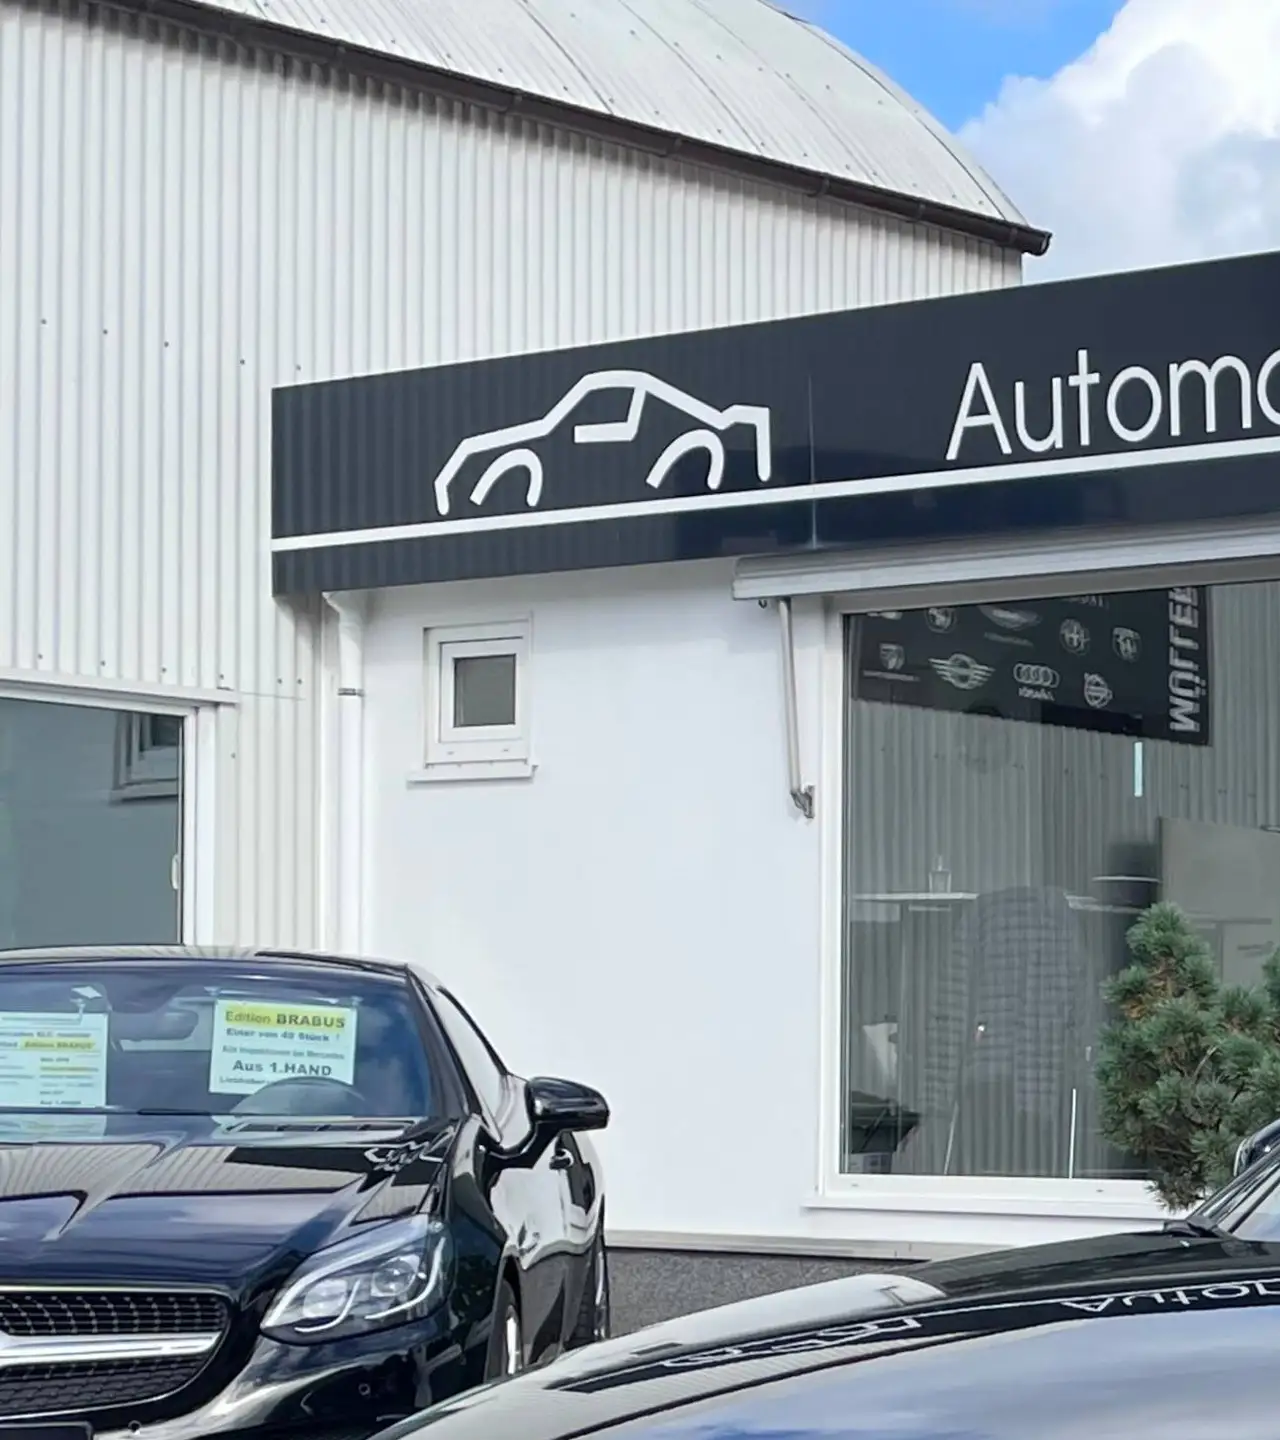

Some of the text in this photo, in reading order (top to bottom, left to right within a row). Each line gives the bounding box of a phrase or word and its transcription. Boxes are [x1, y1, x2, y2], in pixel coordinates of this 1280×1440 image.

[225, 1010, 346, 1029] Edition BRABUS
[232, 1060, 263, 1073] Aus
